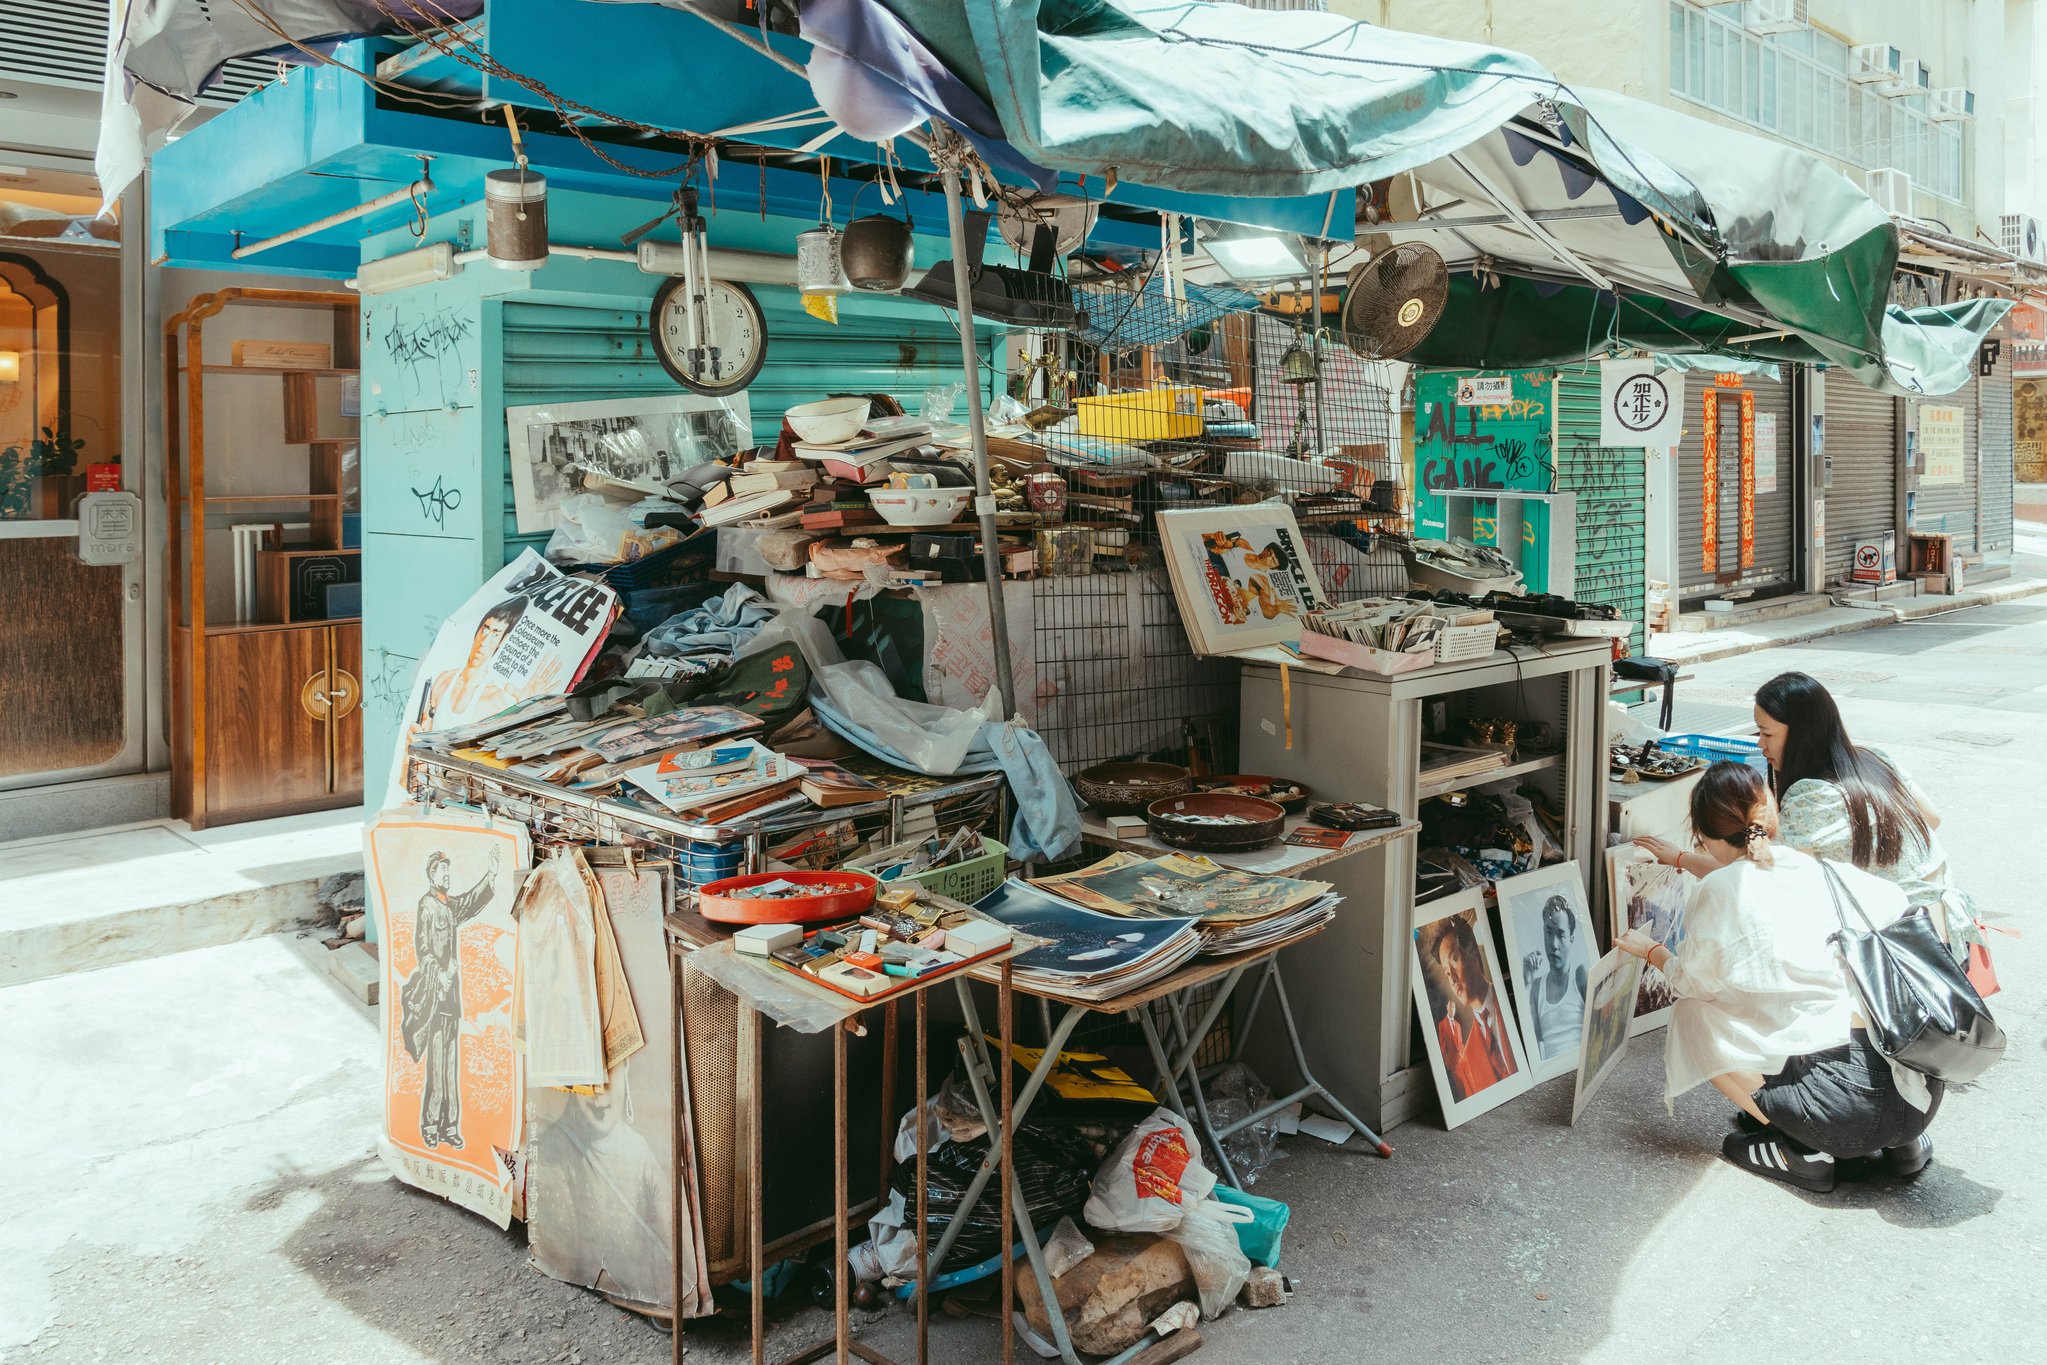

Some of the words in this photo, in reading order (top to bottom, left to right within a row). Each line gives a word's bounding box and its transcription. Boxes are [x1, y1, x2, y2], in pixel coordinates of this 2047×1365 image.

[724, 295, 729, 303] 1
[674, 305, 685, 315] 10
[736, 308, 743, 318] 2
[670, 325, 678, 335] 9
[743, 329, 750, 338] 3
[677, 346, 685, 356] 8
[739, 348, 746, 359] 4
[728, 362, 734, 372] 5
[90, 543, 134, 553] mora
[551, 584, 608, 636] LEE
[514, 624, 545, 649] Colosseum
[521, 615, 535, 631] Once
[535, 624, 551, 641] more
[550, 632, 561, 647] the
[503, 643, 522, 660] sound
[509, 634, 530, 654] echoes
[529, 645, 540, 659] the
[497, 650, 511, 667] fight
[519, 663, 529, 677] the
[493, 661, 514, 679] death!
[943, 872, 959, 889] 10
